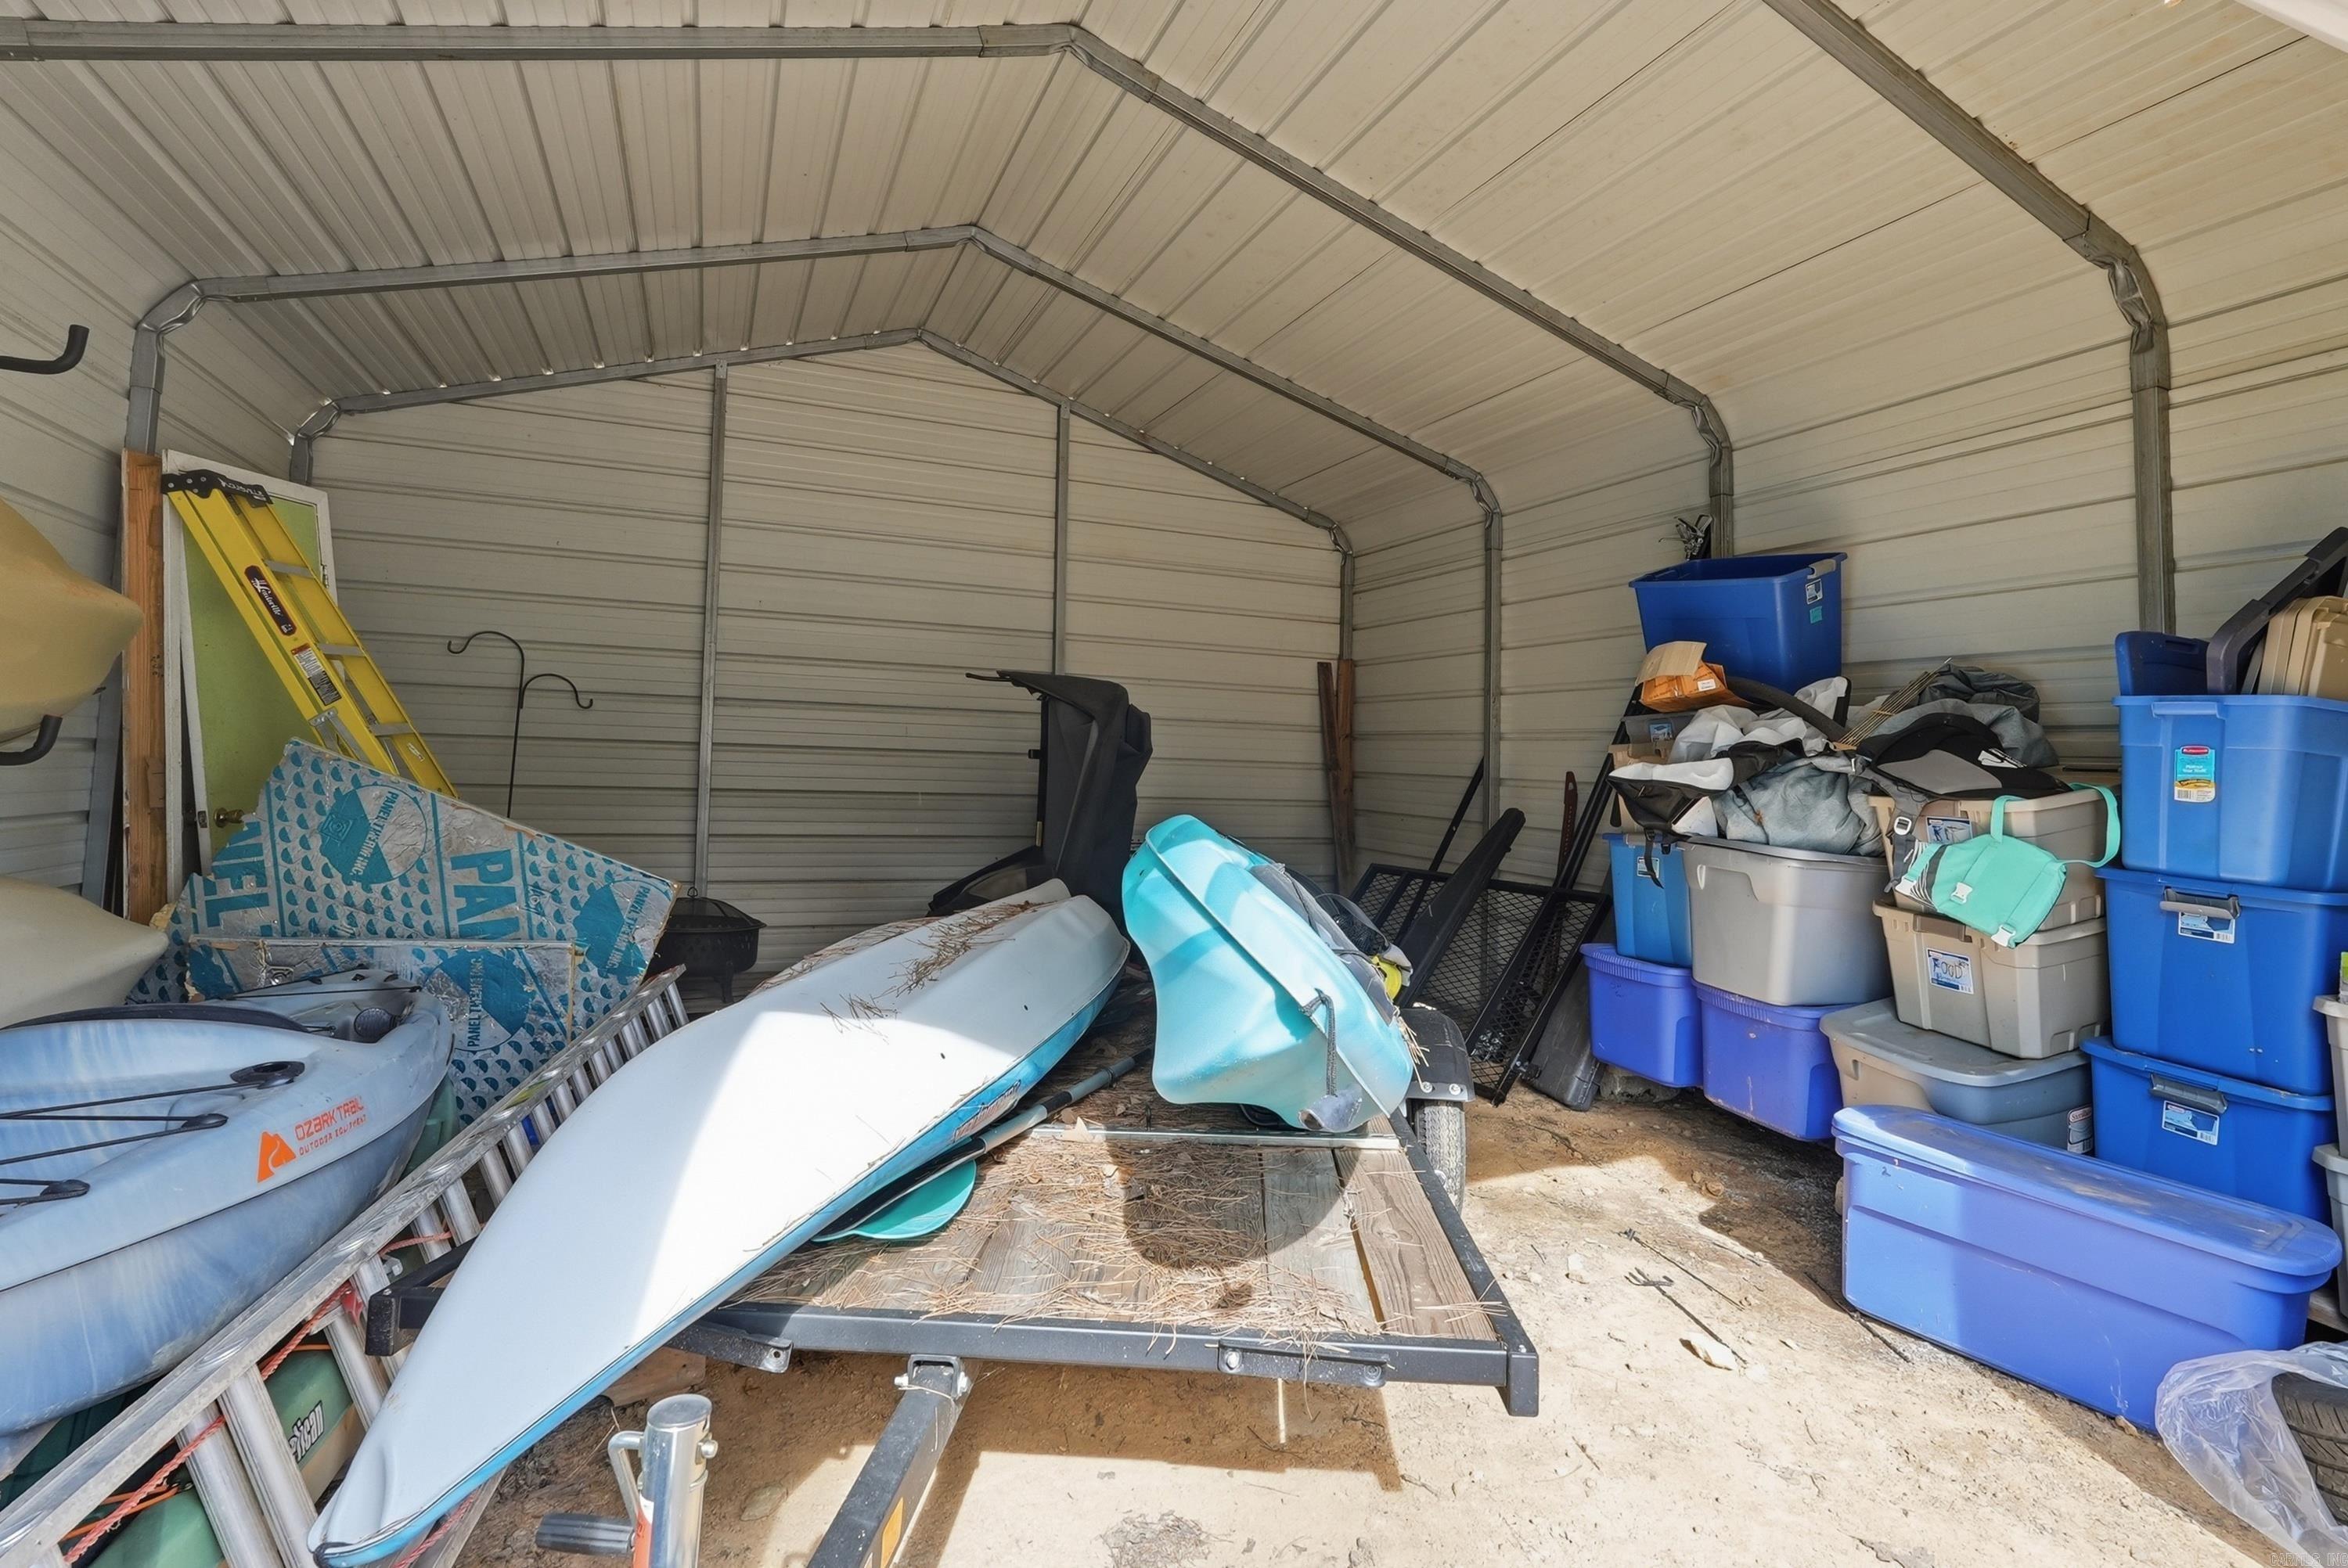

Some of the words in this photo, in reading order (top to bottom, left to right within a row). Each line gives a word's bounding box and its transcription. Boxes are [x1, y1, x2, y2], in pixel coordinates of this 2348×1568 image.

[375, 789, 400, 822] PANEL
[348, 855, 369, 876] INC.
[628, 885, 650, 915] PANEL
[466, 1016, 481, 1047] PANEL
[299, 1132, 333, 1156] OUTDOOR
[287, 1400, 325, 1464] elican
